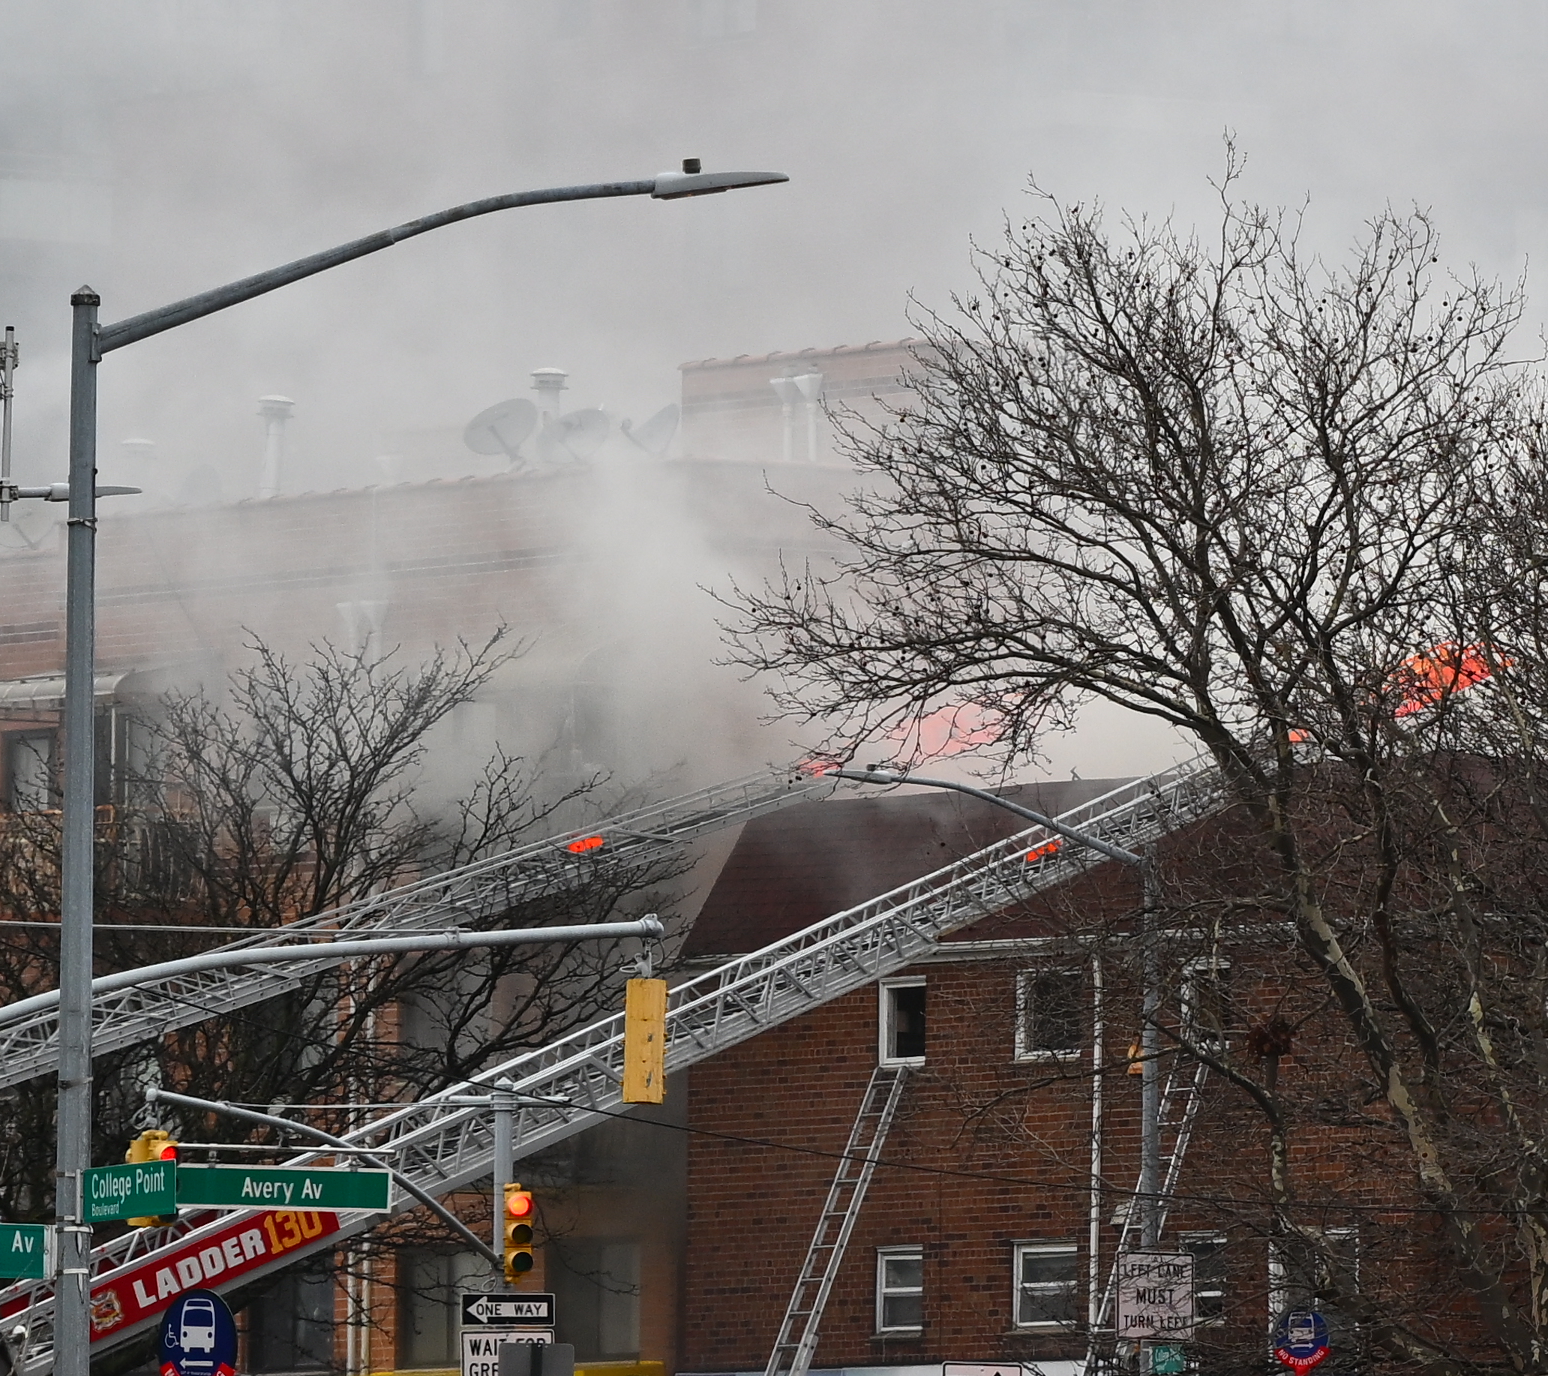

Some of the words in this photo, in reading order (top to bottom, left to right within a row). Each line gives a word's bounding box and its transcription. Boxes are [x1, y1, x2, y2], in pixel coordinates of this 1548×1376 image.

[90, 1174, 131, 1207] College
[135, 1169, 166, 1198] Point
[241, 1177, 294, 1204] Avery
[301, 1176, 323, 1202] Av
[91, 1201, 120, 1216] Boulevard
[11, 1230, 34, 1253] Av
[131, 1228, 266, 1310] LADDER
[262, 1209, 324, 1257] 130
[1123, 1263, 1154, 1278] LEFT
[1158, 1263, 1188, 1278] LANE
[1136, 1288, 1176, 1305] MUST
[475, 1302, 502, 1316] ONE
[514, 1303, 543, 1317] WAY
[1123, 1314, 1154, 1329] TURN
[1160, 1314, 1188, 1330] LEFT
[469, 1337, 508, 1357] WAI
[1278, 1348, 1288, 1361] NO
[1288, 1348, 1325, 1367] STANDING
